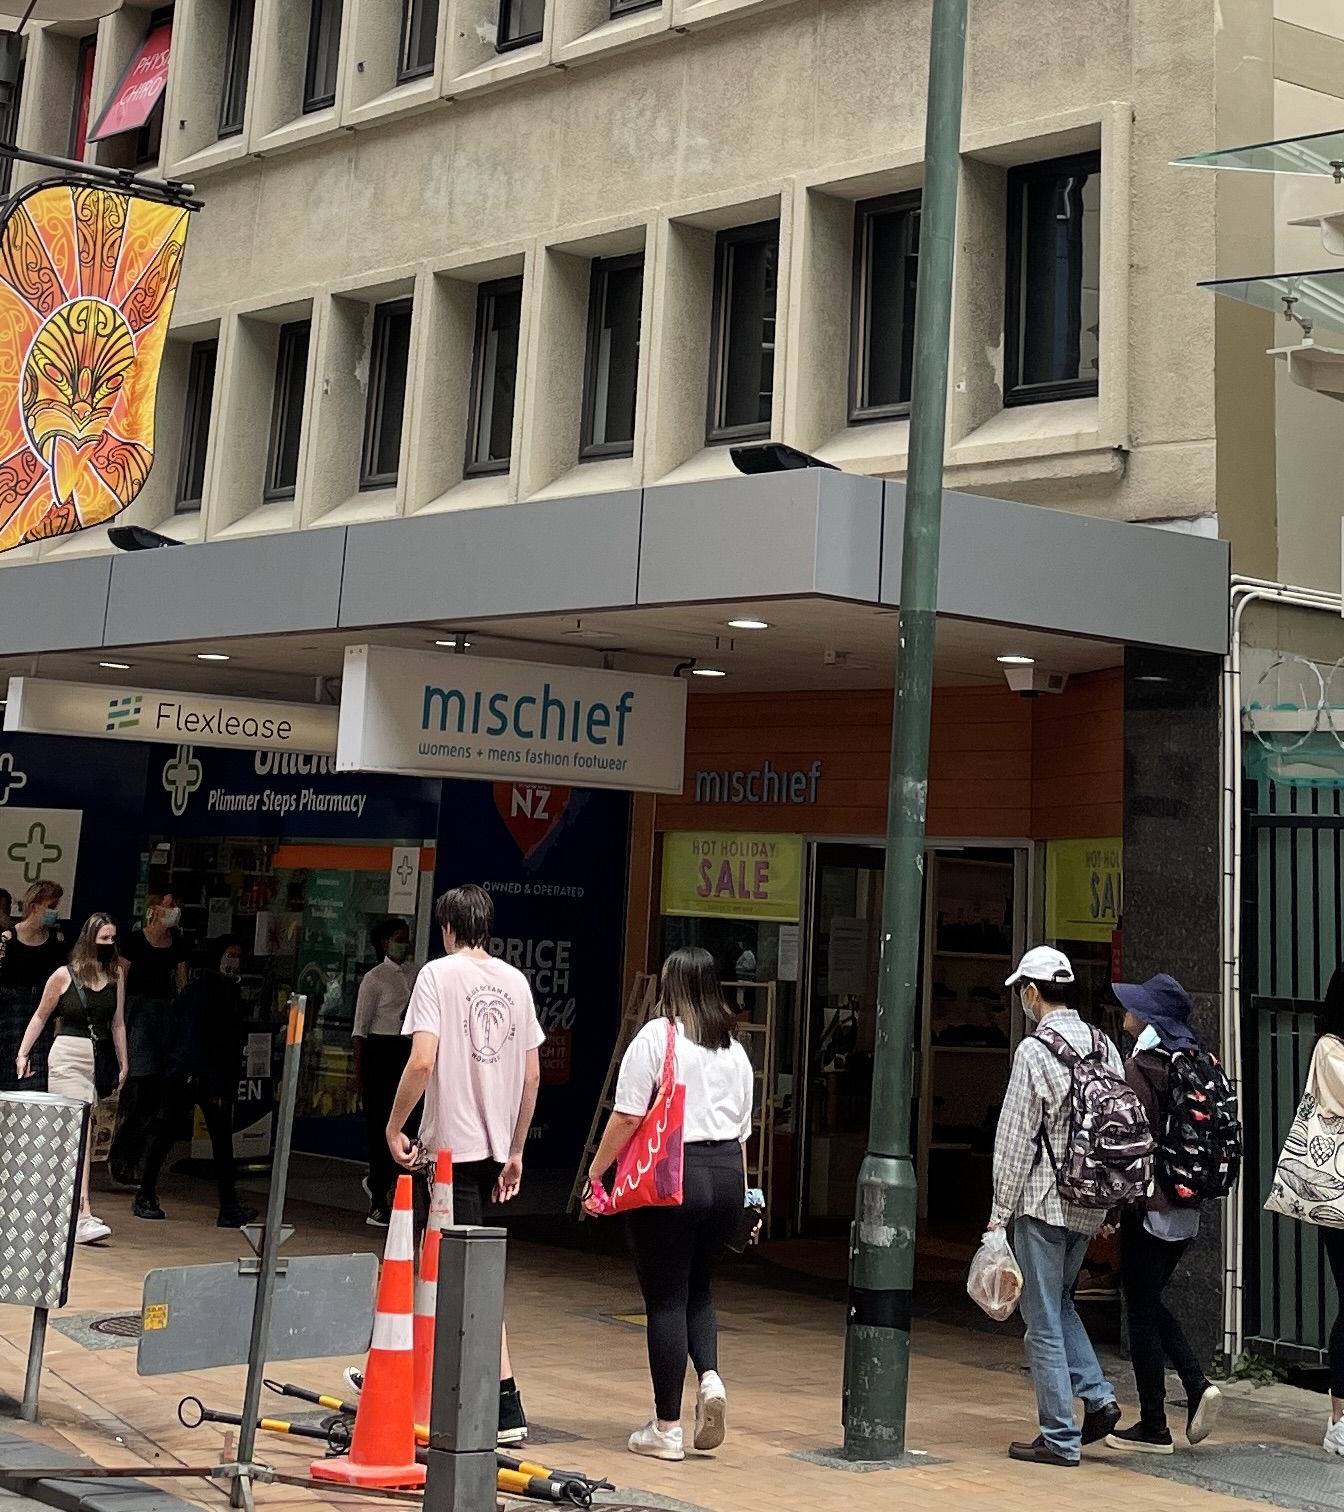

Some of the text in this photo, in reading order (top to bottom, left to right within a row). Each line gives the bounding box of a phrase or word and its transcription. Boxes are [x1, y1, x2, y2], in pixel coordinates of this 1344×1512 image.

[157, 702, 292, 740] Flexlease
[421, 683, 635, 747] mischief
[418, 742, 471, 759] womens
[487, 748, 521, 763] mens
[525, 748, 570, 767] fashion
[573, 751, 628, 771] footwear
[696, 759, 823, 803] mischief
[208, 788, 367, 818] Plimmer Steps Pharmacy
[510, 788, 552, 819] NZ
[692, 840, 776, 857] HOT HOLIDAY
[483, 881, 522, 894] OWNED
[533, 884, 585, 898] OPERATED
[696, 858, 770, 900] SALE
[1090, 871, 1122, 919] SAL
[489, 938, 572, 969] PRICE
